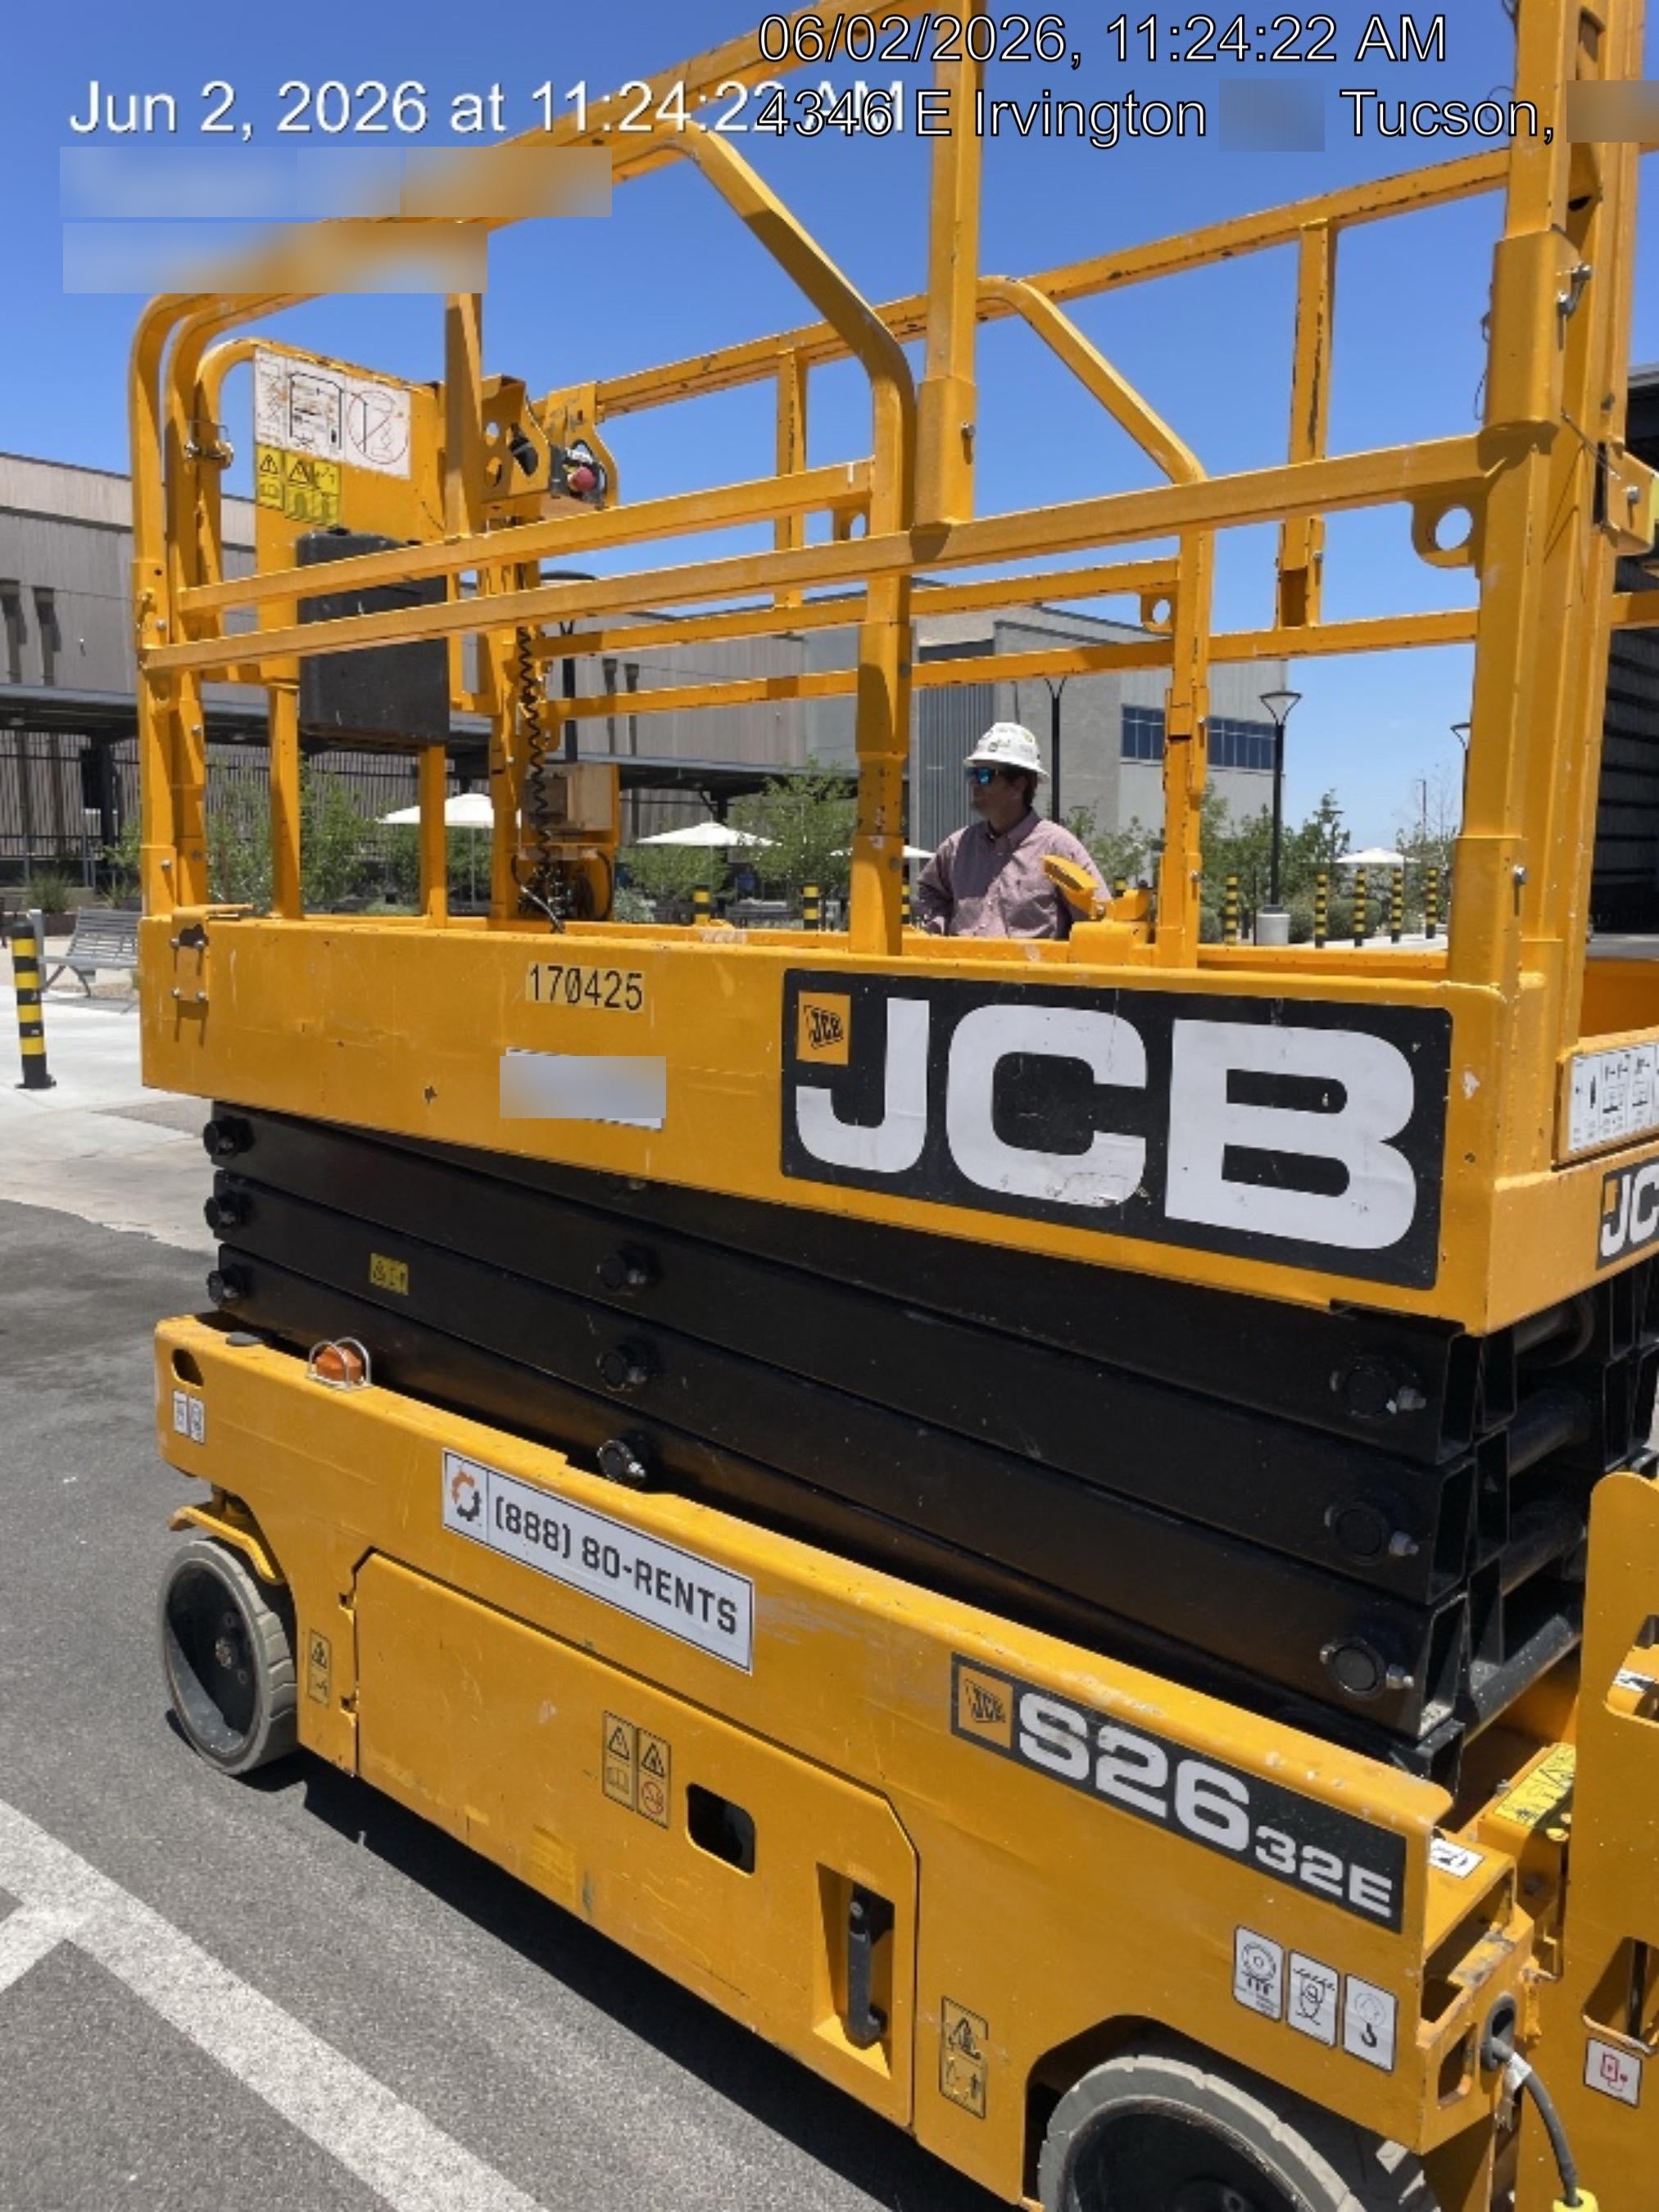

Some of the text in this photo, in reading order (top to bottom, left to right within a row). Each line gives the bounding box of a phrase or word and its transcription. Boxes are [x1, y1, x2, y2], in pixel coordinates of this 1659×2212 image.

[530, 963, 643, 1011] 170425
[796, 996, 1417, 1250] JCB
[496, 1496, 737, 1635] (888) 80-RENTS
